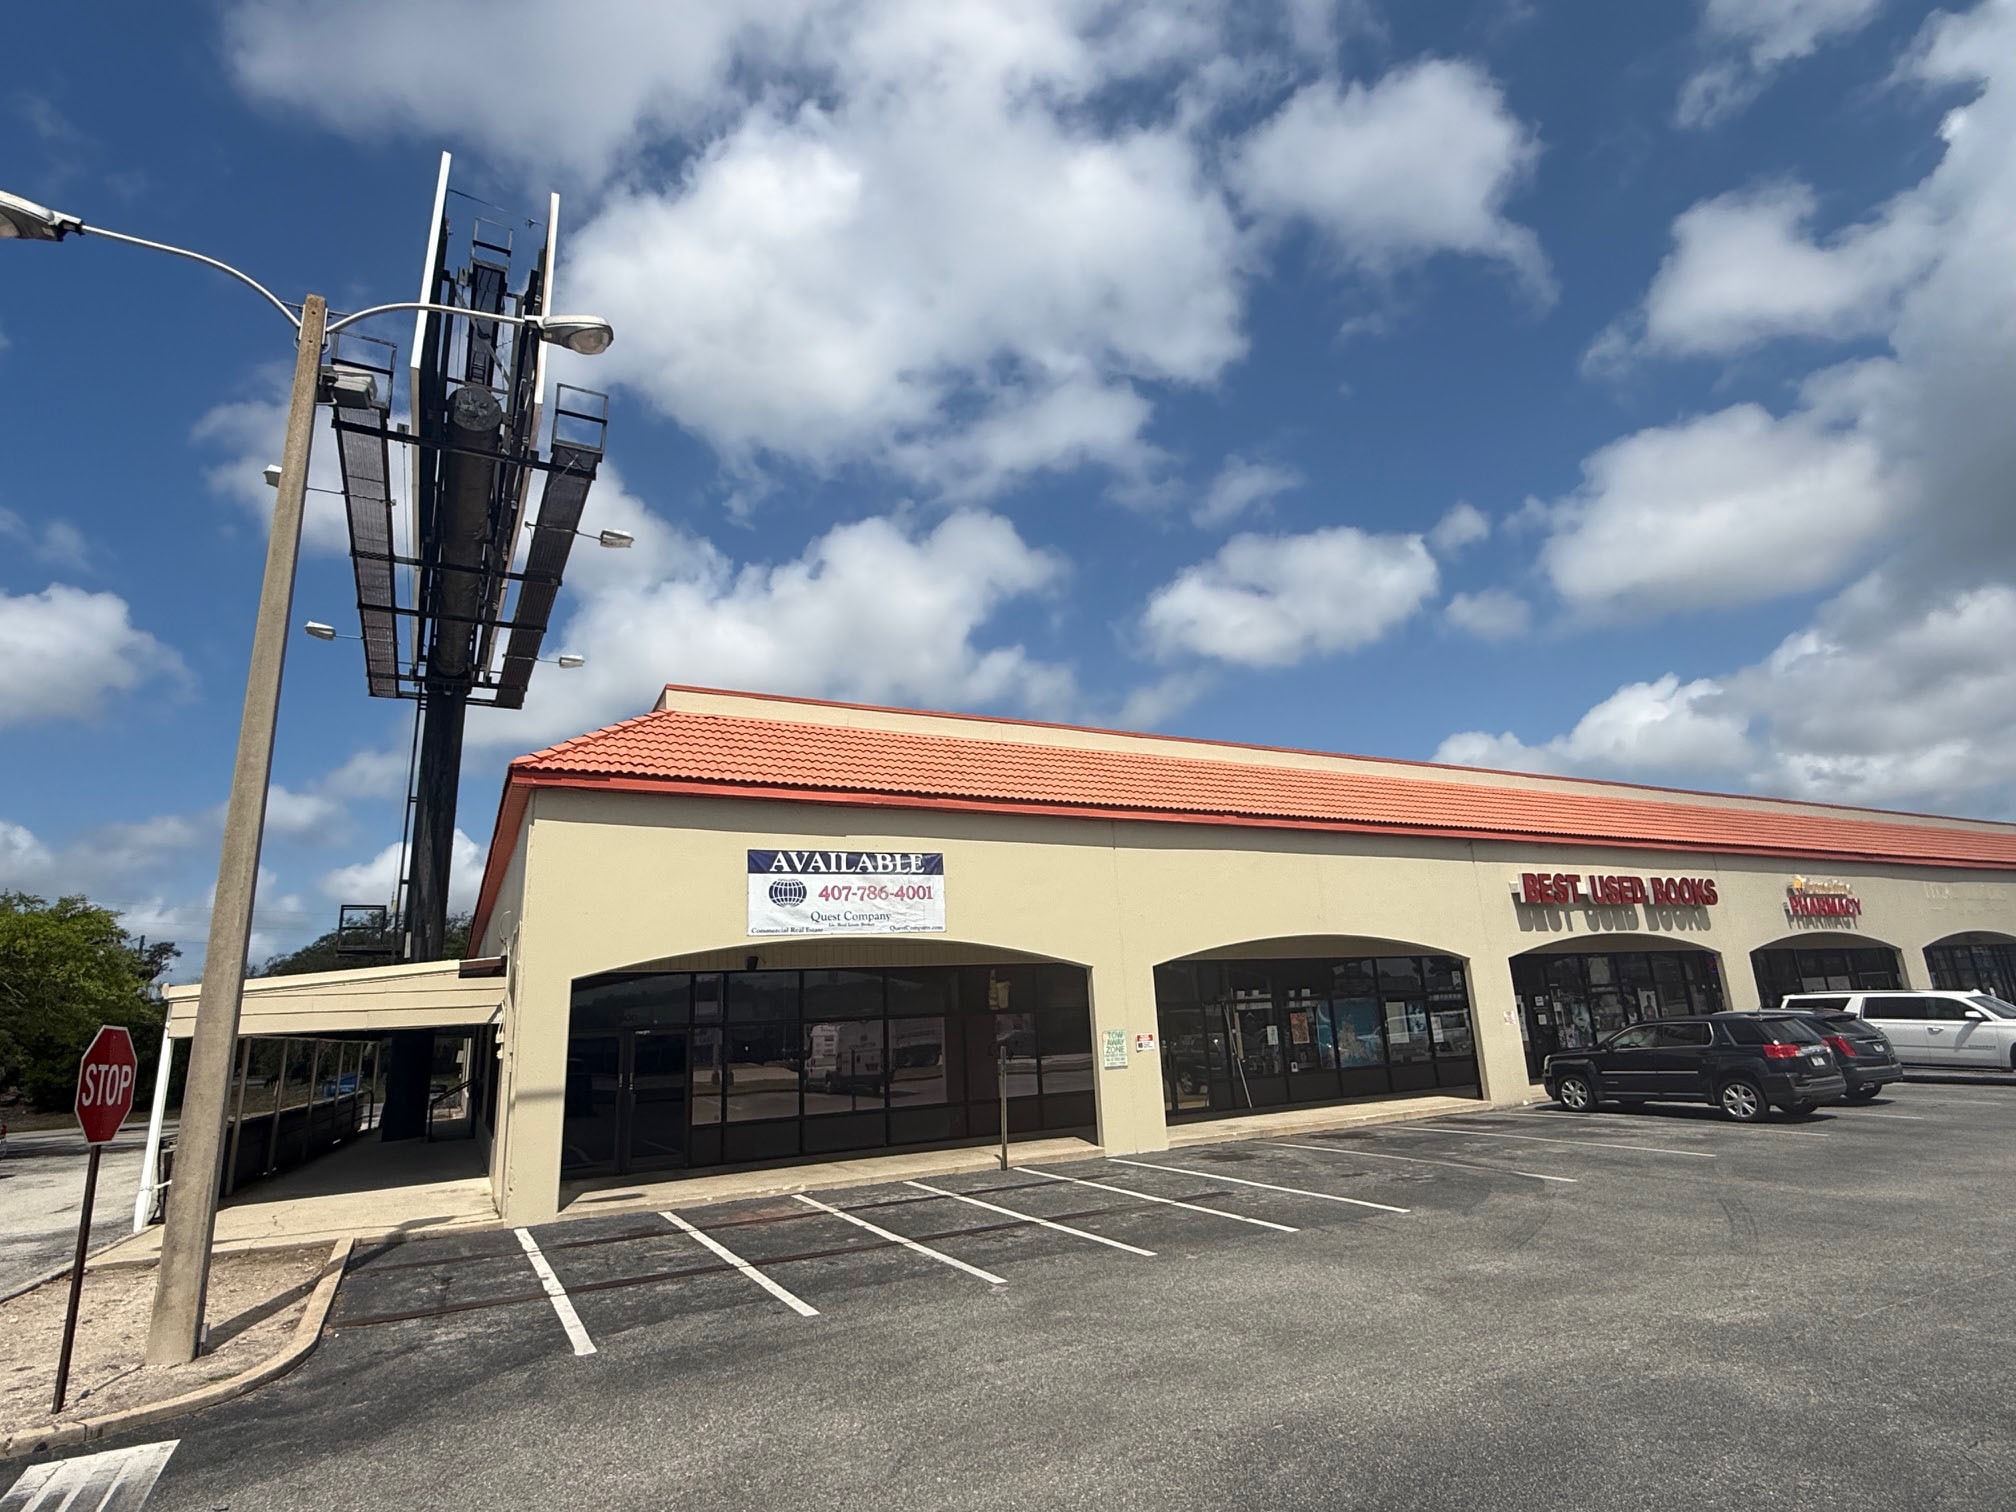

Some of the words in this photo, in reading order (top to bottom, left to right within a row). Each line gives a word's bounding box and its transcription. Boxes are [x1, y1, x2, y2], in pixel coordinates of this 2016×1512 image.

[769, 851, 925, 873] AVAILABLE
[818, 885, 934, 902] 407-786-4001
[1520, 873, 1581, 903] BEST
[1587, 875, 1646, 905] USED
[1649, 877, 1719, 906] BOOKS
[1789, 895, 1862, 916] PHARMACY
[810, 911, 841, 923] Quest
[843, 911, 891, 922] Company
[81, 1063, 132, 1107] STOP
